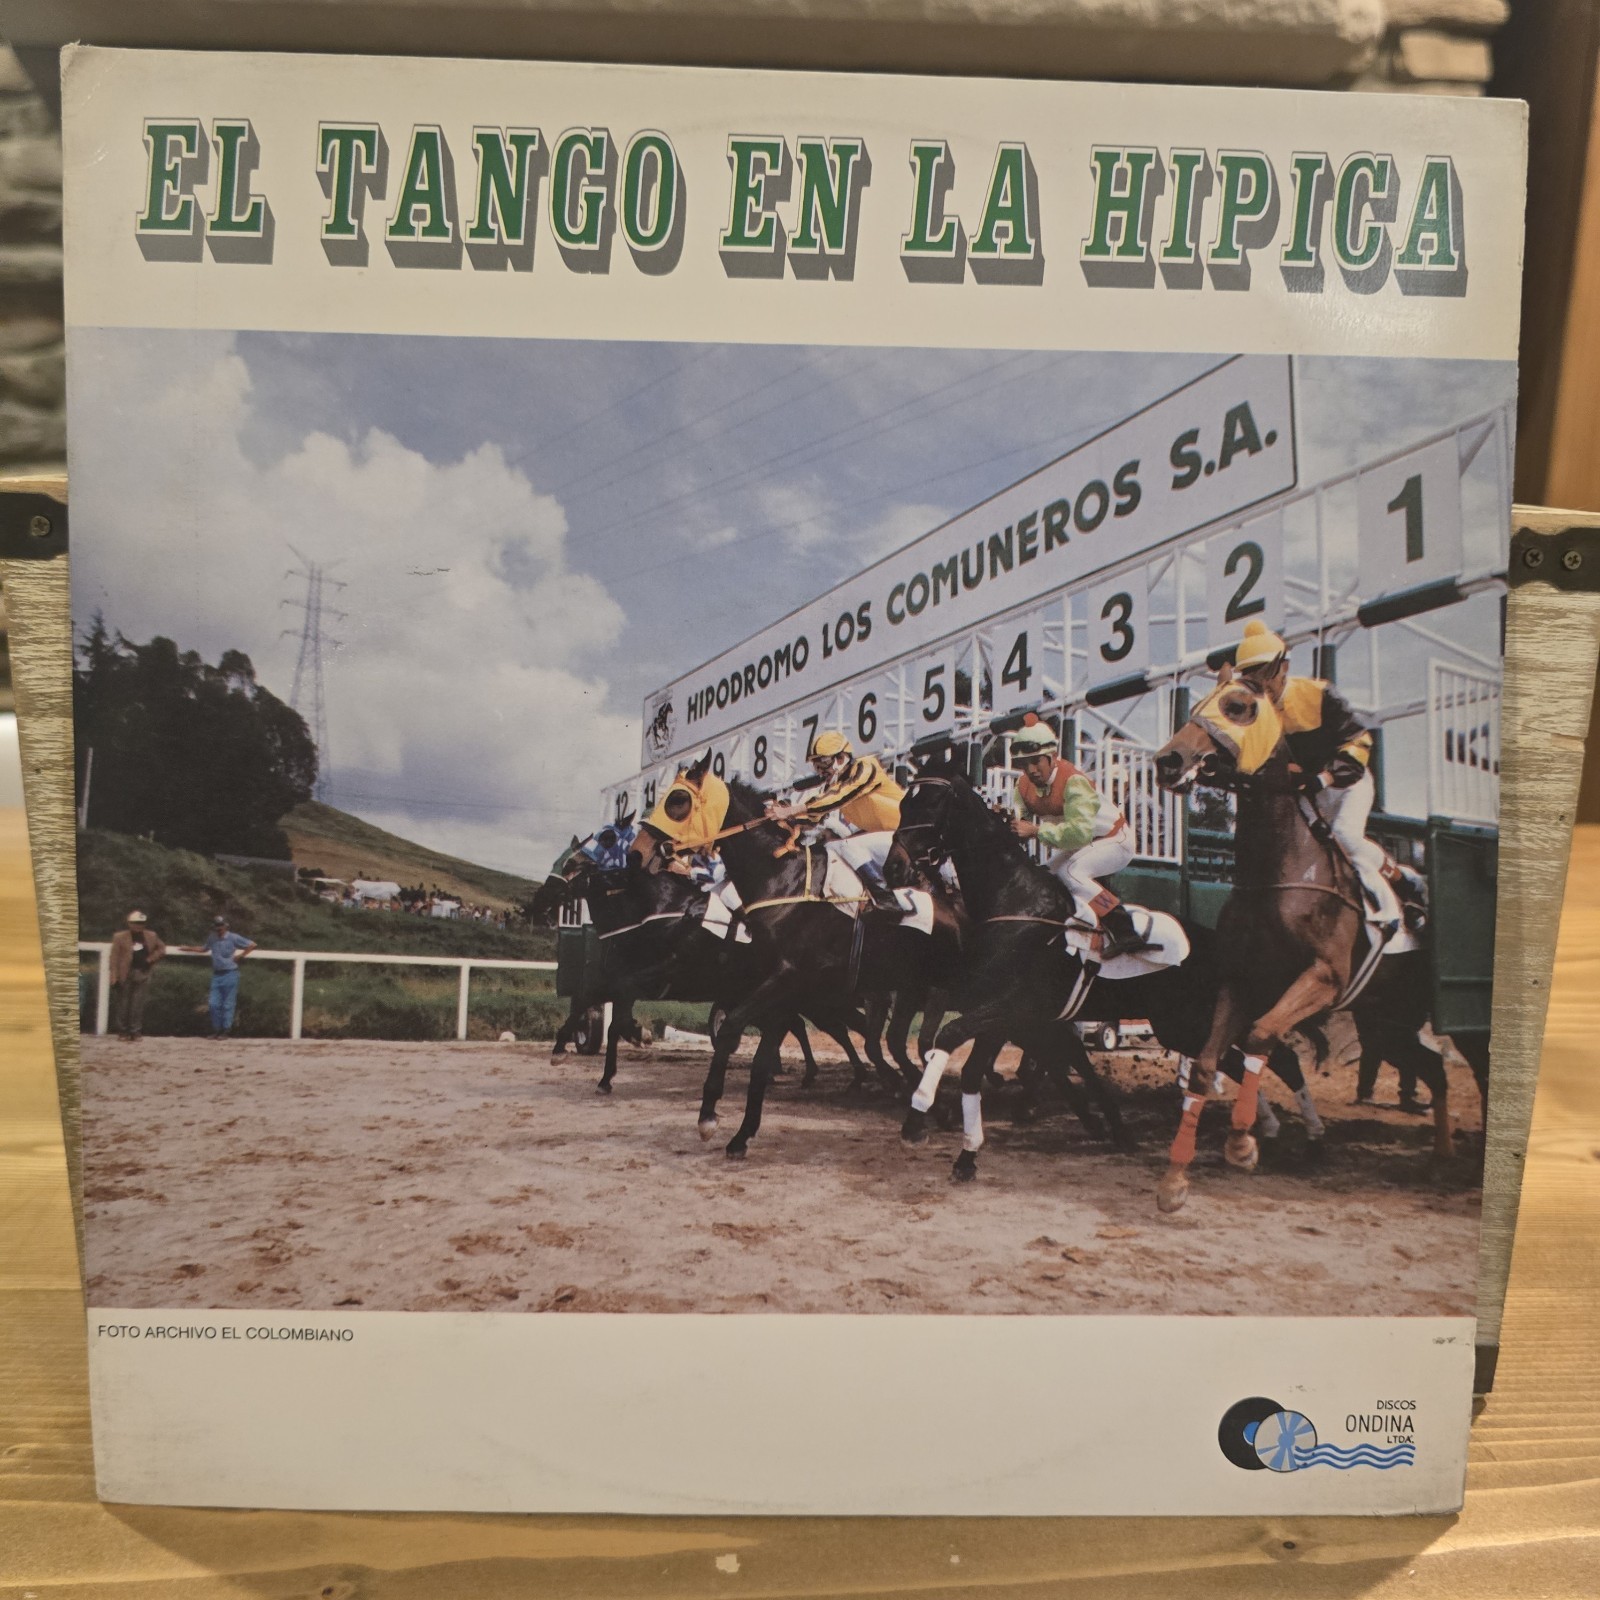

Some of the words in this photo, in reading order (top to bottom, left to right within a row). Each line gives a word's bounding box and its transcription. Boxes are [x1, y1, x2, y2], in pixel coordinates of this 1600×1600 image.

[135, 117, 275, 264] EL
[317, 121, 687, 275] TANGO
[719, 134, 872, 281] EN
[900, 139, 1043, 286] LA
[1080, 144, 1468, 298] HIPICA
[1387, 473, 1424, 563] 1
[687, 635, 810, 724] HIPODROMO
[823, 602, 871, 659] LOS
[886, 459, 1142, 625] COMUNEROS
[1169, 400, 1278, 491] S.A.
[1224, 541, 1265, 623] 2
[1100, 592, 1134, 663] 3
[1001, 632, 1032, 691] 4
[858, 692, 877, 743] 6
[923, 664, 945, 722] 5
[754, 735, 767, 779] 8
[802, 714, 819, 761] 7
[98, 1325, 140, 1338] FOTO
[145, 1326, 217, 1339] ARCHIVO
[222, 1327, 241, 1339] EL
[246, 1327, 354, 1342] COLOMBIANO
[1345, 1414, 1415, 1433] ONDINA
[1376, 1399, 1417, 1410] DISCOS
